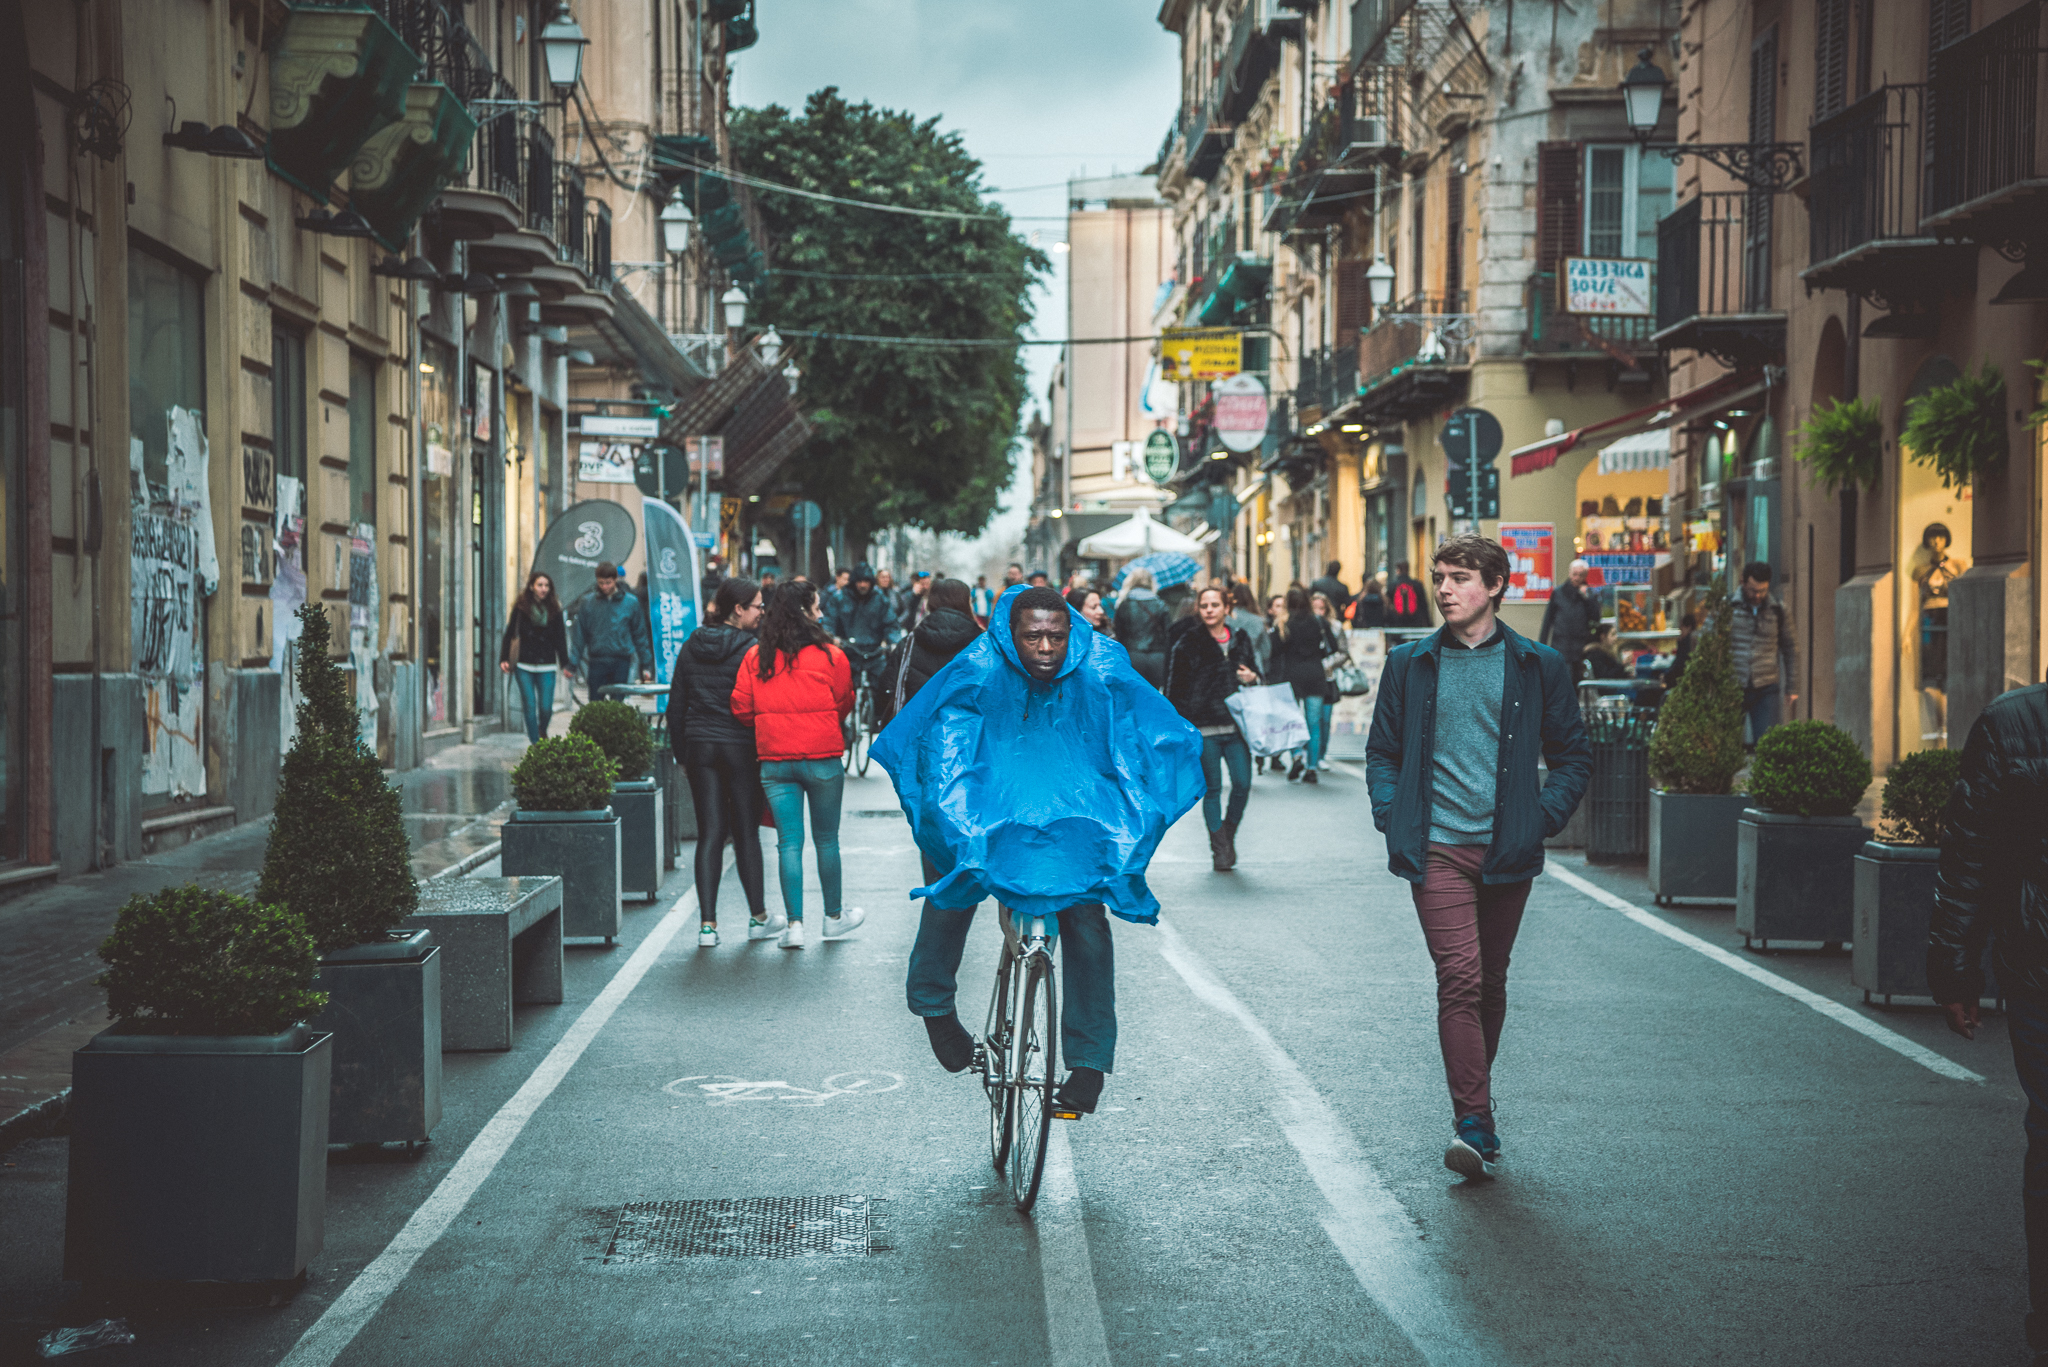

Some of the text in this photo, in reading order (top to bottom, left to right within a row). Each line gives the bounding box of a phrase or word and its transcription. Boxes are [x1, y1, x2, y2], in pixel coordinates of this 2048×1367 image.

[1570, 260, 1644, 278] FABBRICA
[1572, 279, 1615, 294] BORSE
[574, 520, 604, 558] 3
